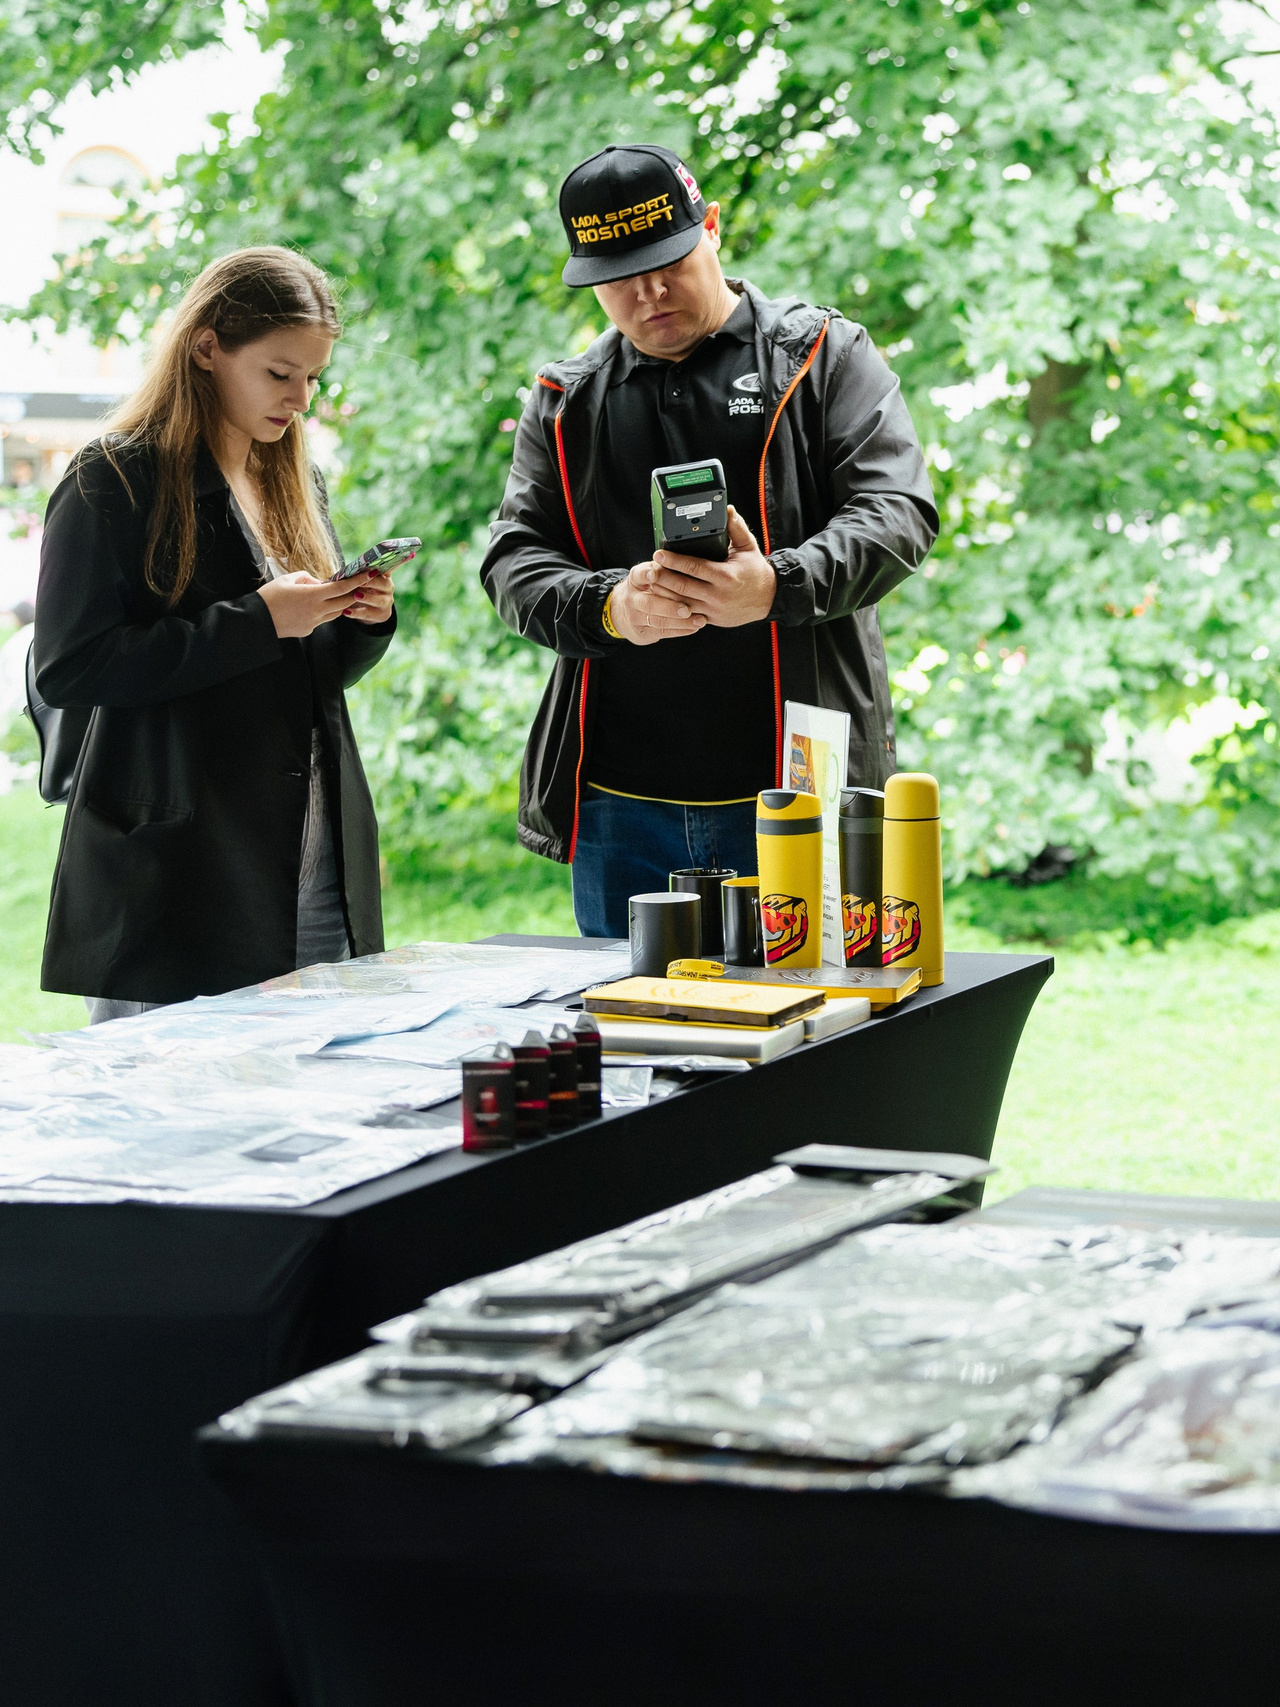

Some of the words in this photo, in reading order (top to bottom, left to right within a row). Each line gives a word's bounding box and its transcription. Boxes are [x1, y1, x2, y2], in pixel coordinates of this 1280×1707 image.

[571, 214, 602, 229] LADA
[604, 193, 669, 223] SPORT
[728, 397, 755, 406] LADA
